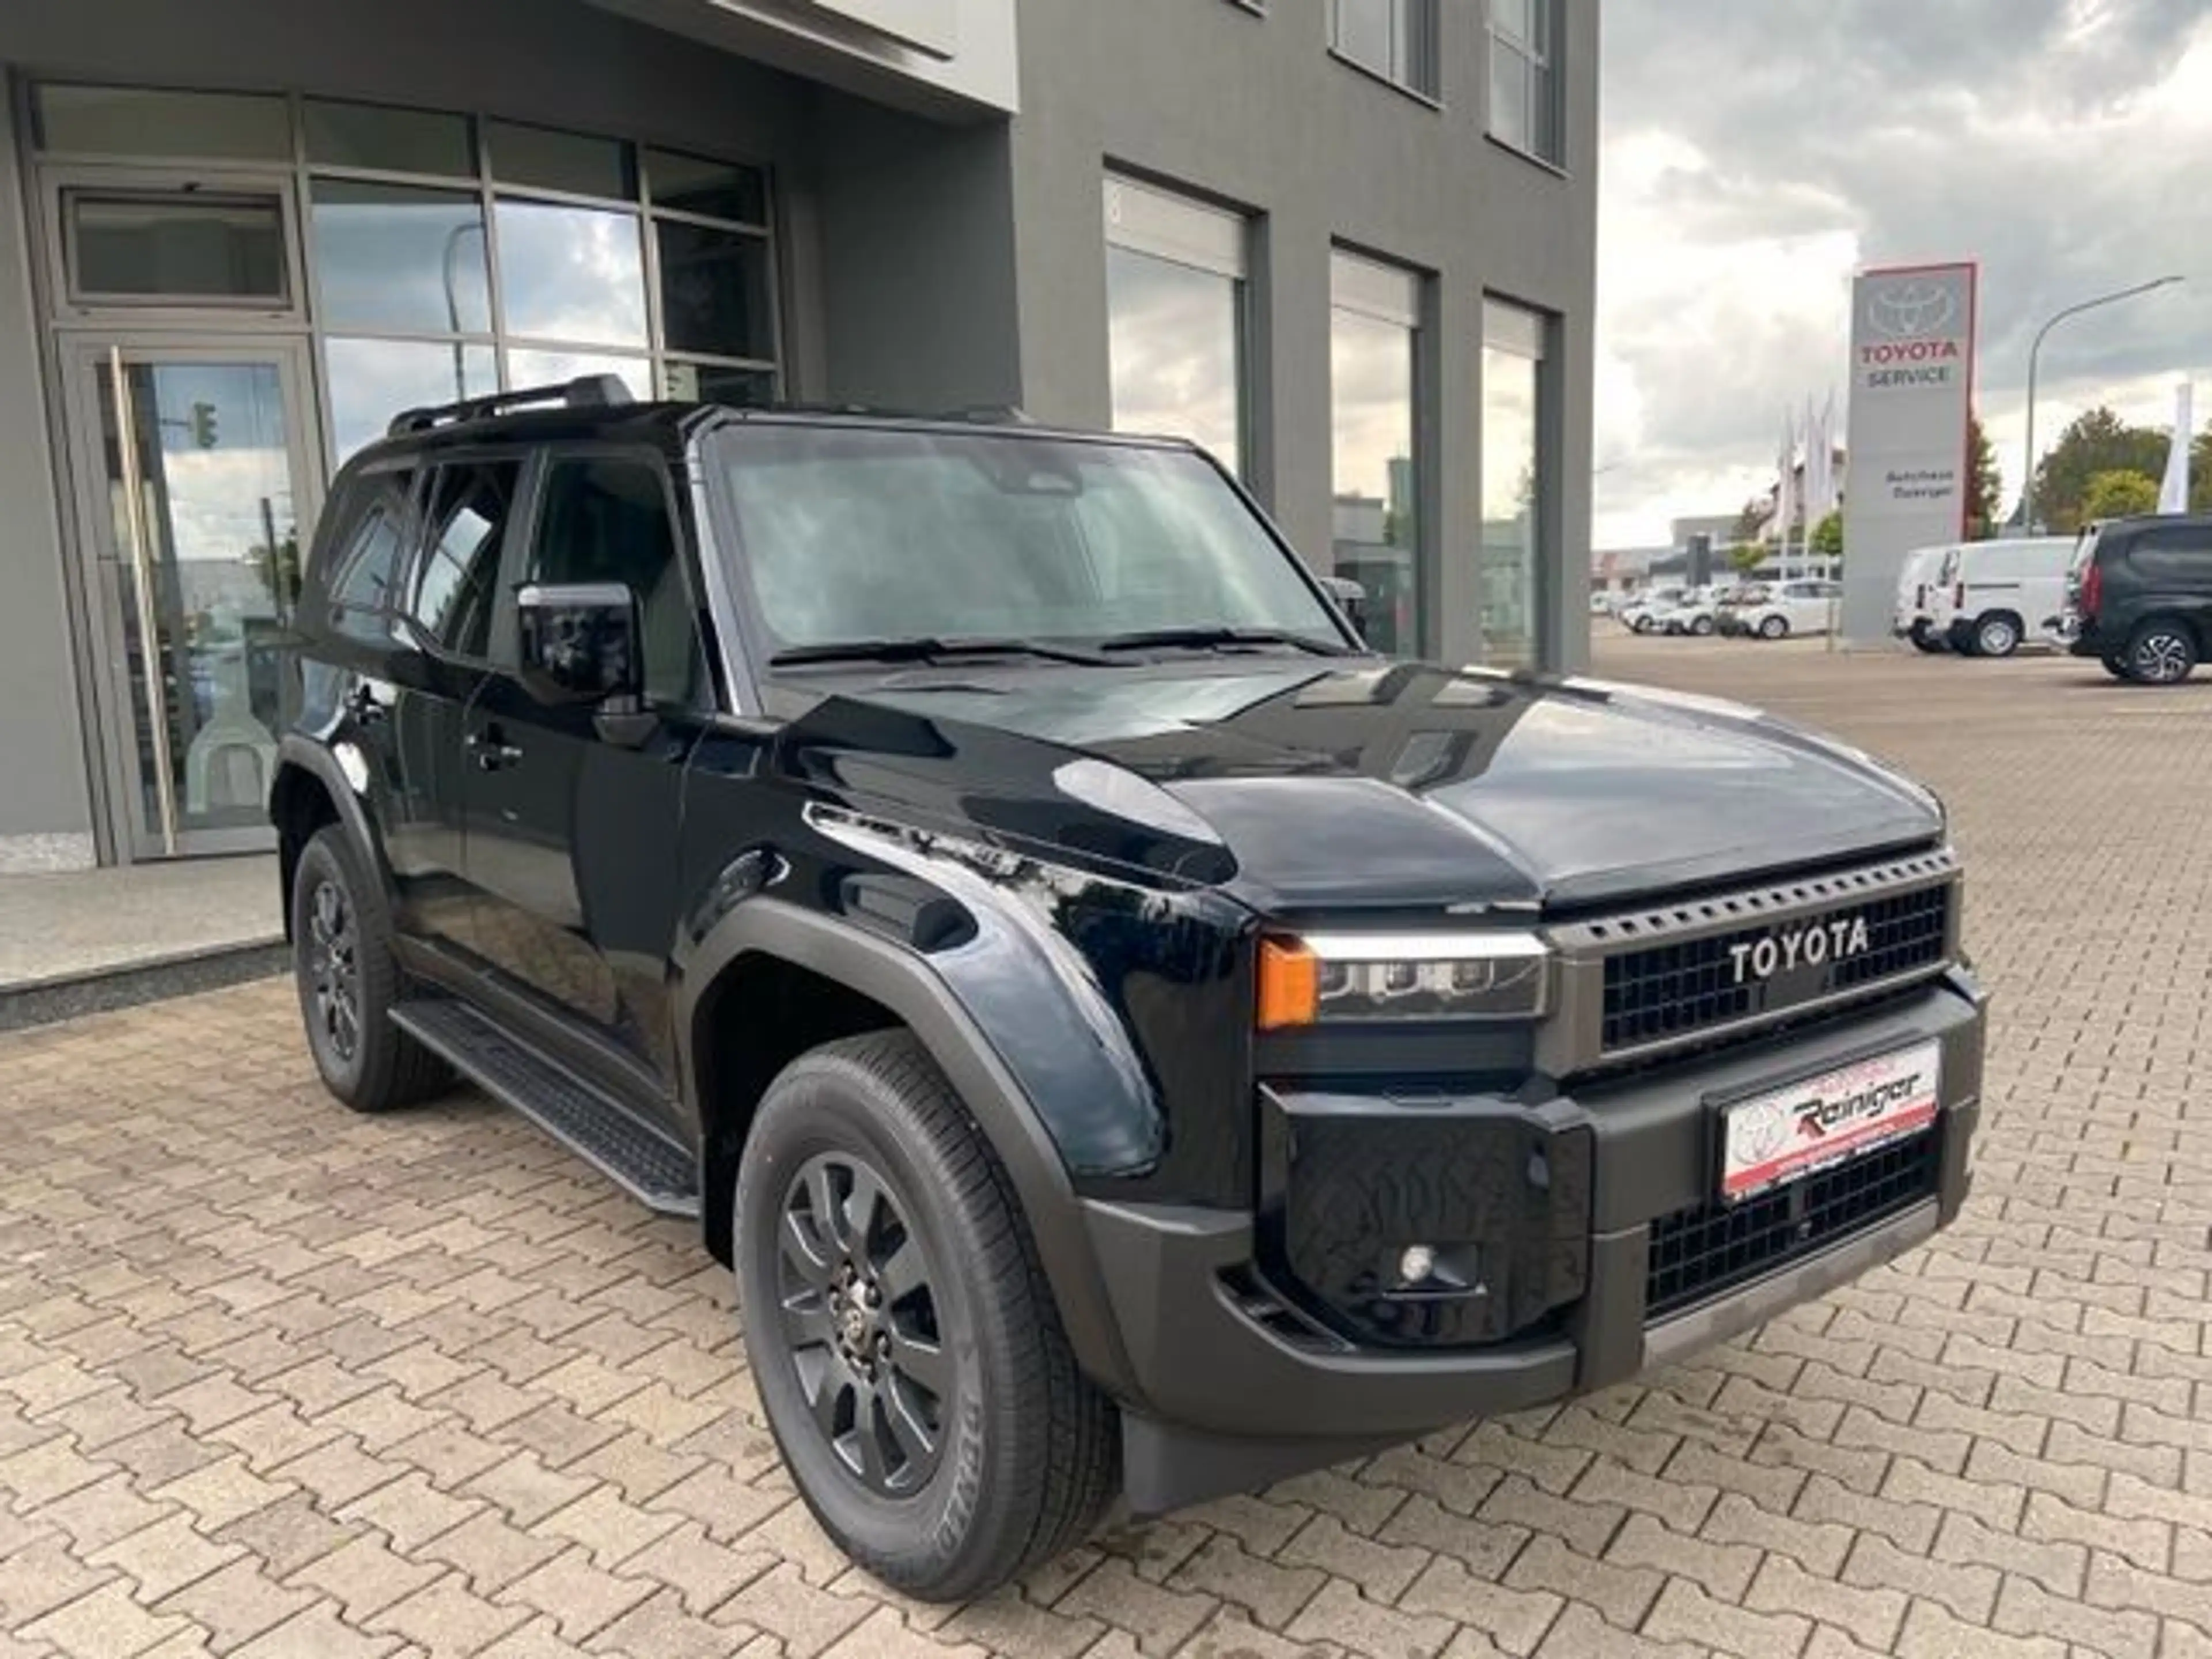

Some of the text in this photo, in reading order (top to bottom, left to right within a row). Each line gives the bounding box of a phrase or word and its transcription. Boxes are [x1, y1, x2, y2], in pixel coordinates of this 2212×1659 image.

[1861, 341, 1957, 363] TOYOTA
[1867, 366, 1950, 388] SERVICE
[1729, 916, 1868, 982] TOYOTA
